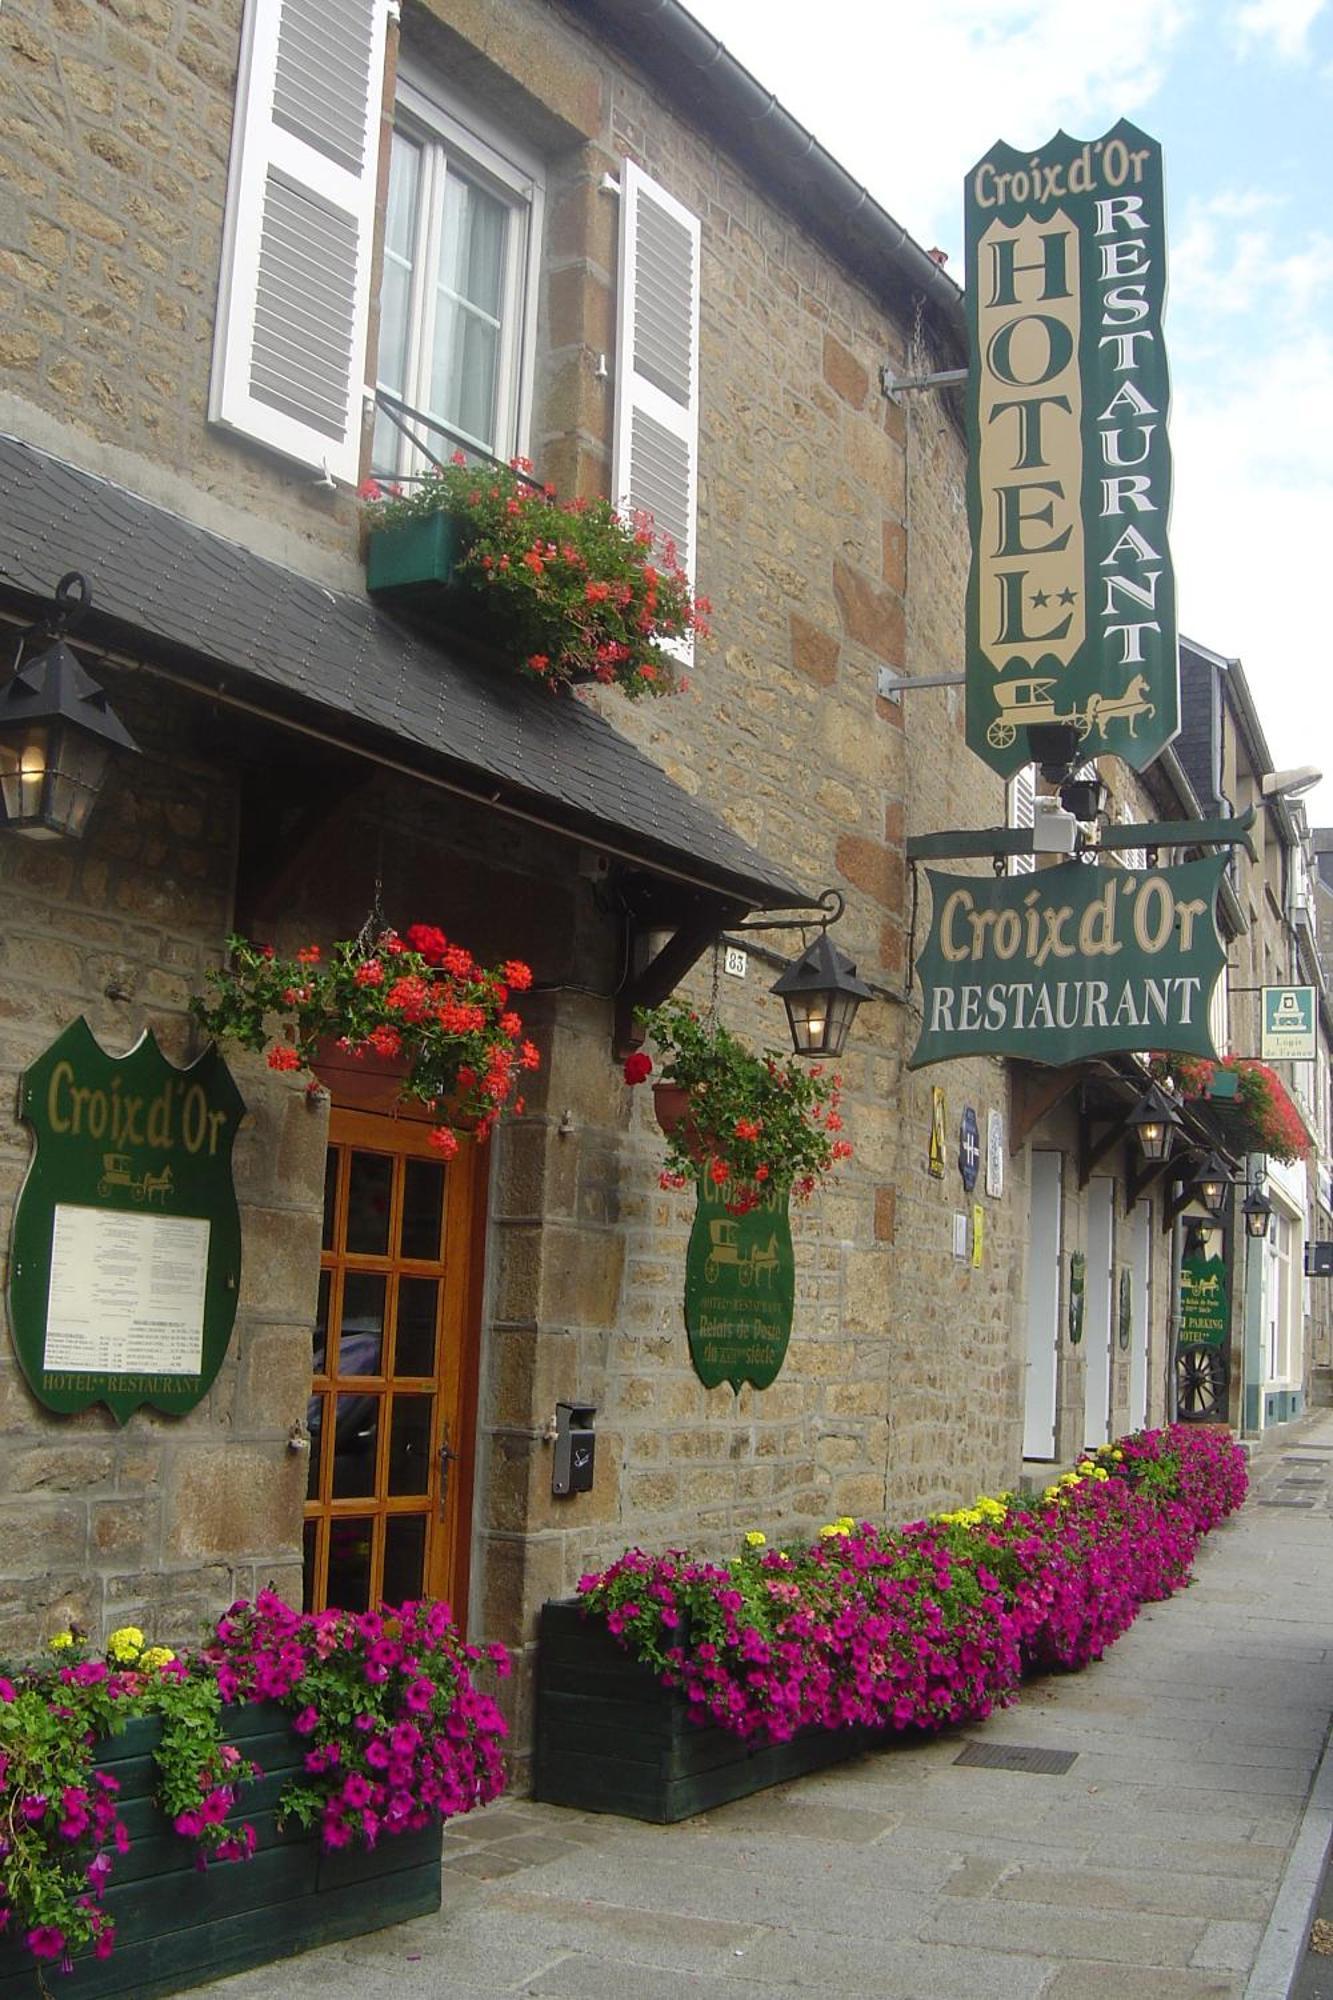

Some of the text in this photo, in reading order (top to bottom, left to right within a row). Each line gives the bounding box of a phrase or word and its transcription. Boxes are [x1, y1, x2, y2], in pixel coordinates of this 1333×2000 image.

[984, 231, 1074, 646] HOTEL
[1094, 195, 1162, 664] RESTAURANT
[929, 977, 1201, 1031] RESTAURANT
[43, 1374, 201, 1394] HOTEL RESTAURANT
